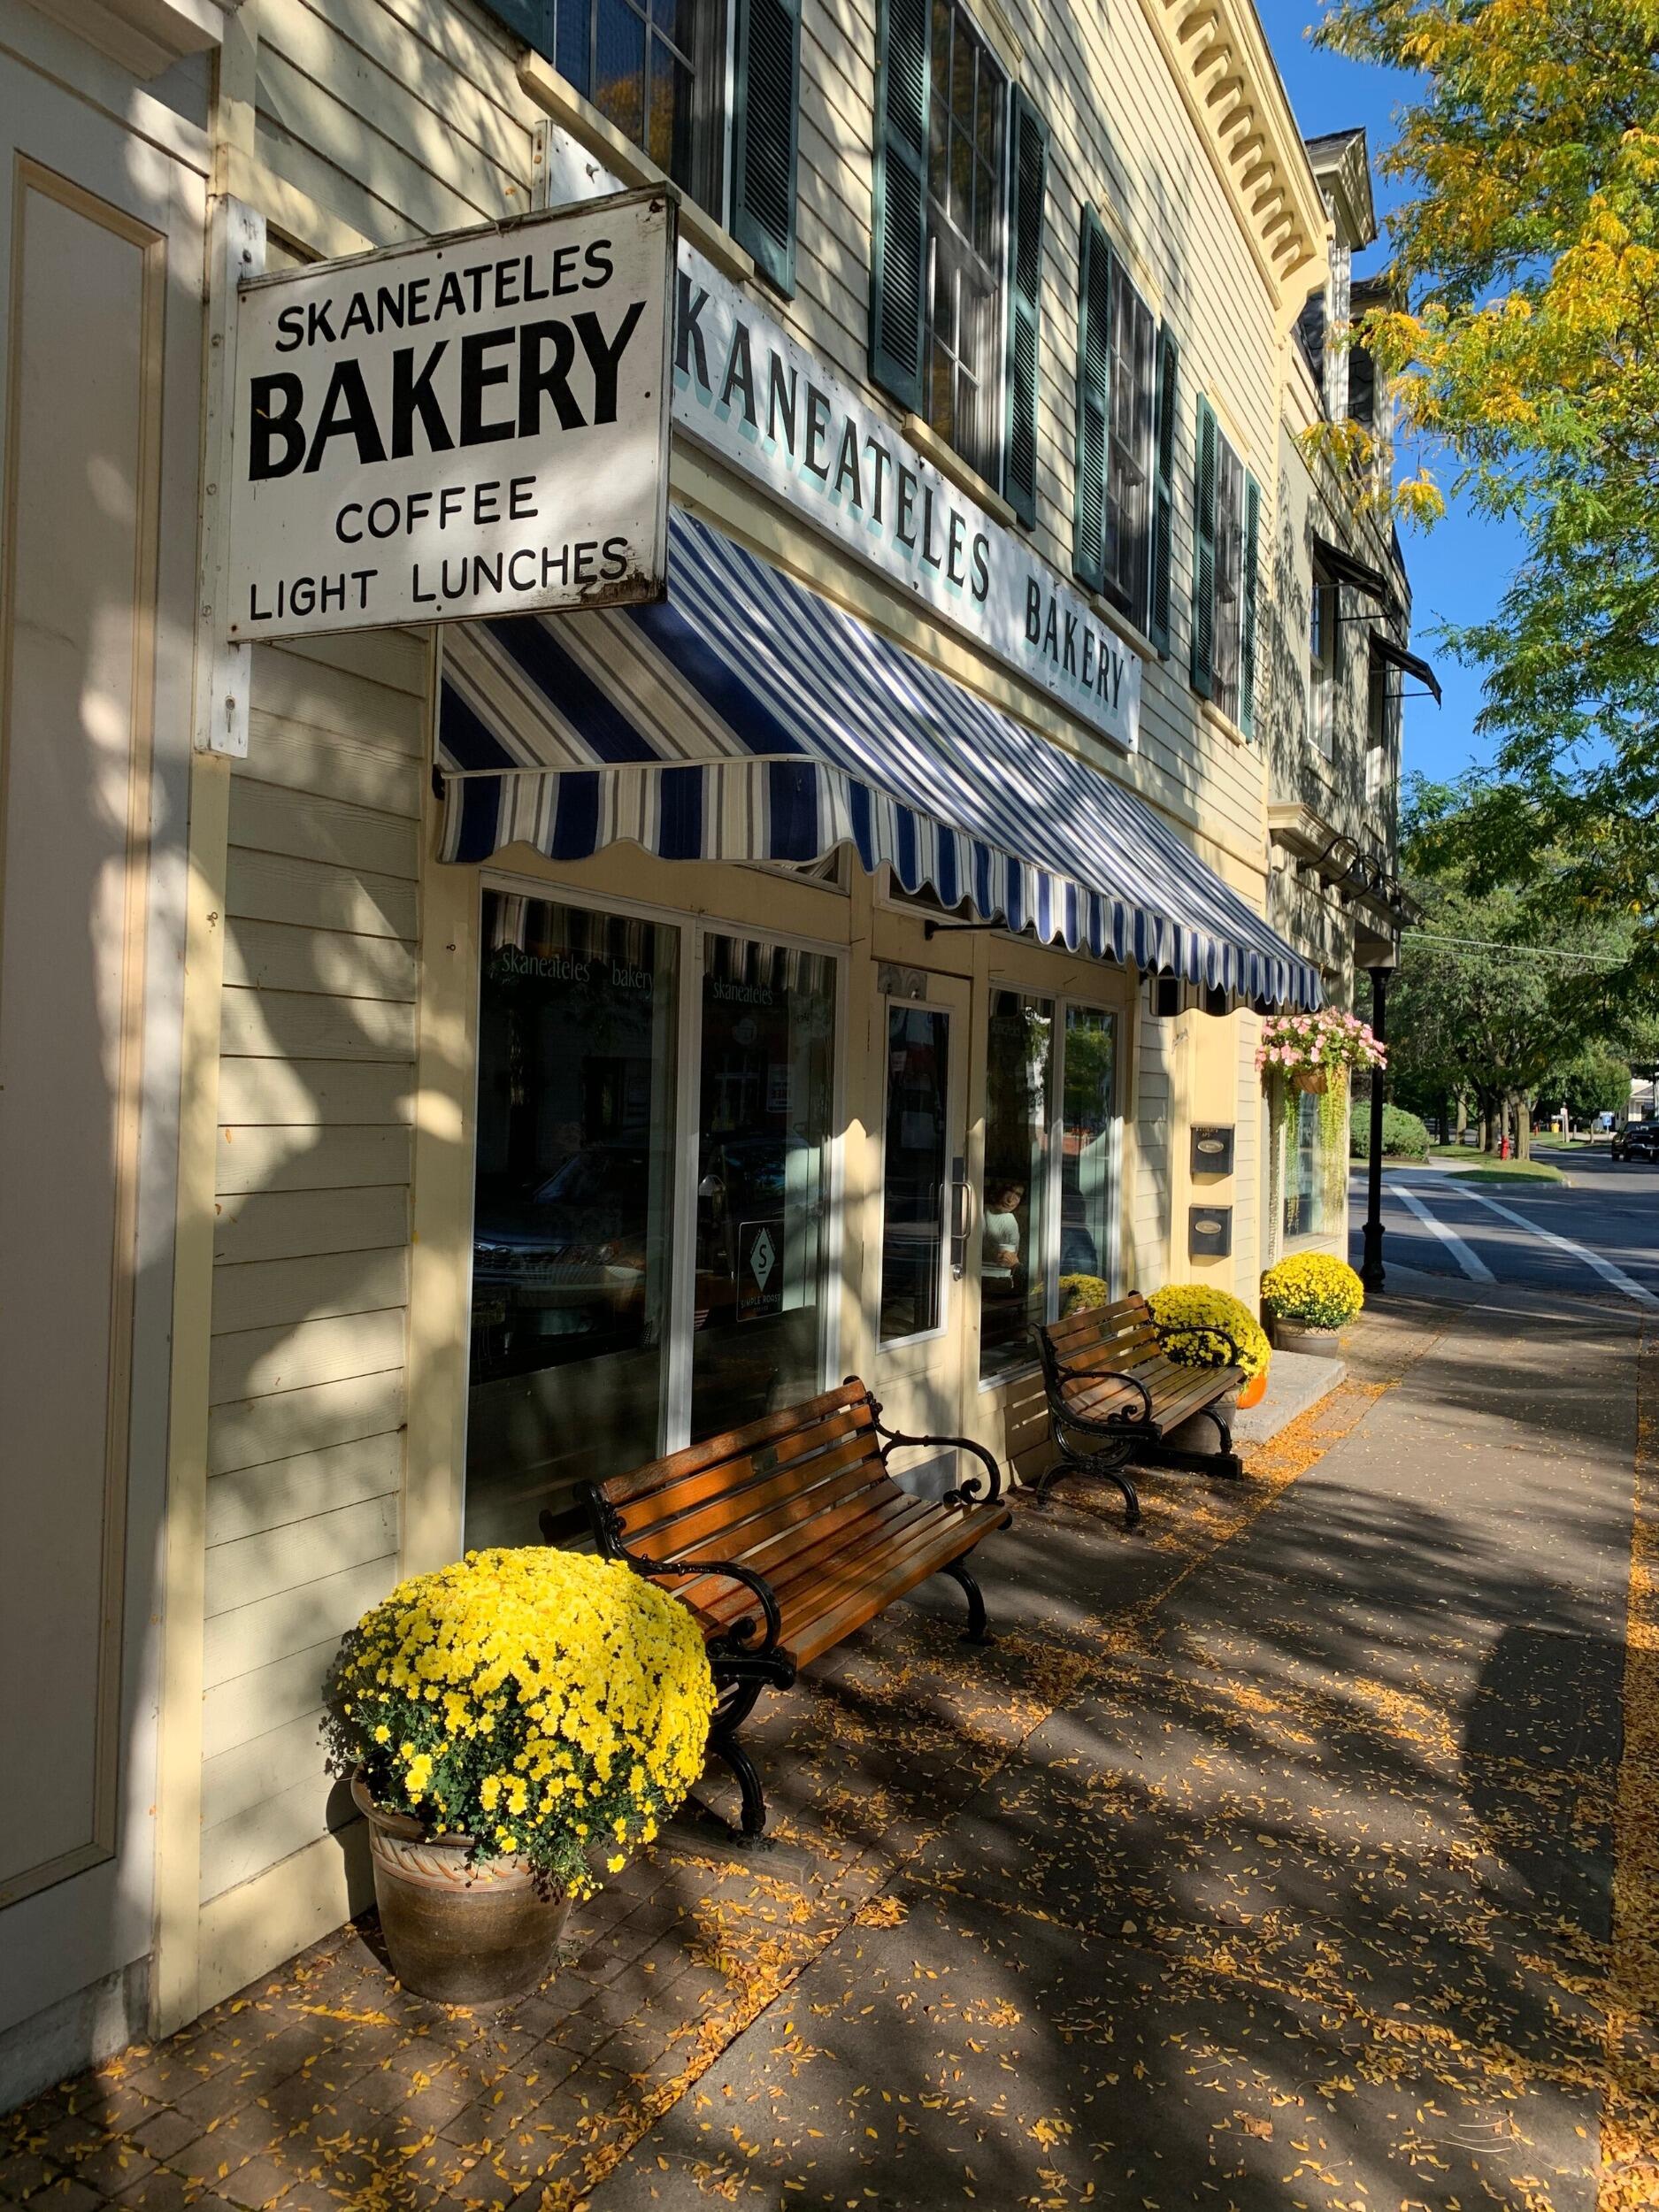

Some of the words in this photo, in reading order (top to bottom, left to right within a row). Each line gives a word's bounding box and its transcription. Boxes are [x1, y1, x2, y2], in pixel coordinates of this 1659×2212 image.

[275, 240, 614, 352] SKANEATELES
[249, 301, 648, 481] BAKERY
[335, 475, 539, 543] COFFEE
[674, 269, 989, 603] KANEATELES
[1025, 575, 1125, 710] BAKERY
[250, 569, 379, 620] LIGHT
[412, 536, 628, 603] LUNCHES
[502, 945, 591, 983] skaneateles
[612, 959, 653, 999] bakery
[713, 977, 774, 1006] skaneateles
[741, 1295, 761, 1309] SIMPLE
[763, 1294, 780, 1303] ROAST
